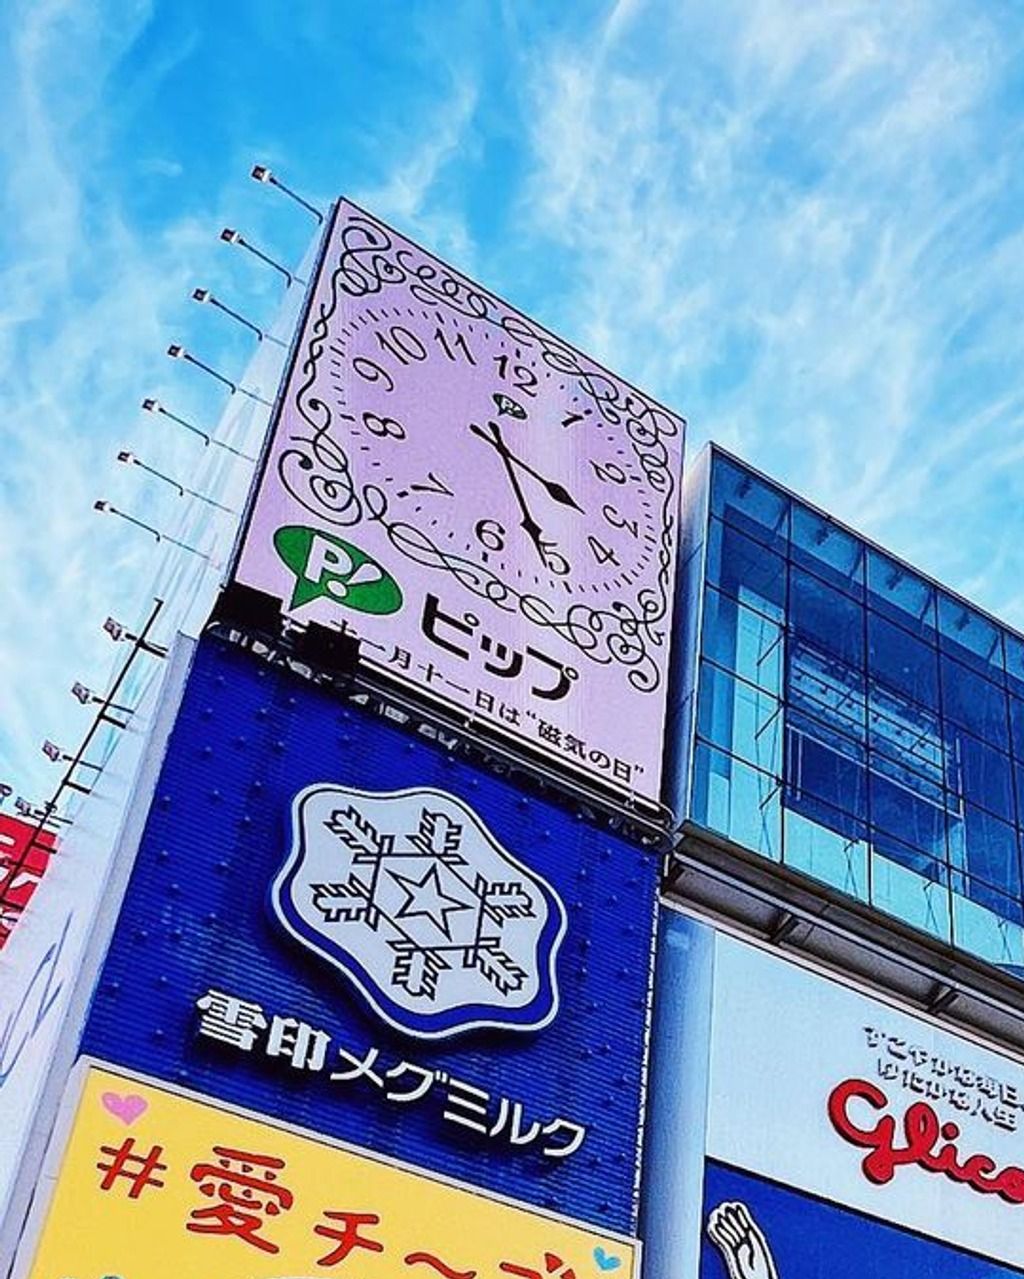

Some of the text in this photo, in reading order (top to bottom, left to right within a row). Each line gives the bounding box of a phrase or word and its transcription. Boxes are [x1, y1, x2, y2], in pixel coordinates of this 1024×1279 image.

[376, 326, 427, 365] 10
[434, 328, 476, 365] 11
[352, 357, 394, 391] 9
[494, 355, 538, 397] 12
[363, 413, 406, 440] 8
[410, 472, 454, 497] 7
[589, 460, 627, 484] 2
[475, 520, 505, 550] 6
[602, 504, 638, 538] 3
[587, 536, 620, 567] 4
[421, 592, 579, 700] ピップ
[196, 988, 588, 1158] 雪印メグミルク
